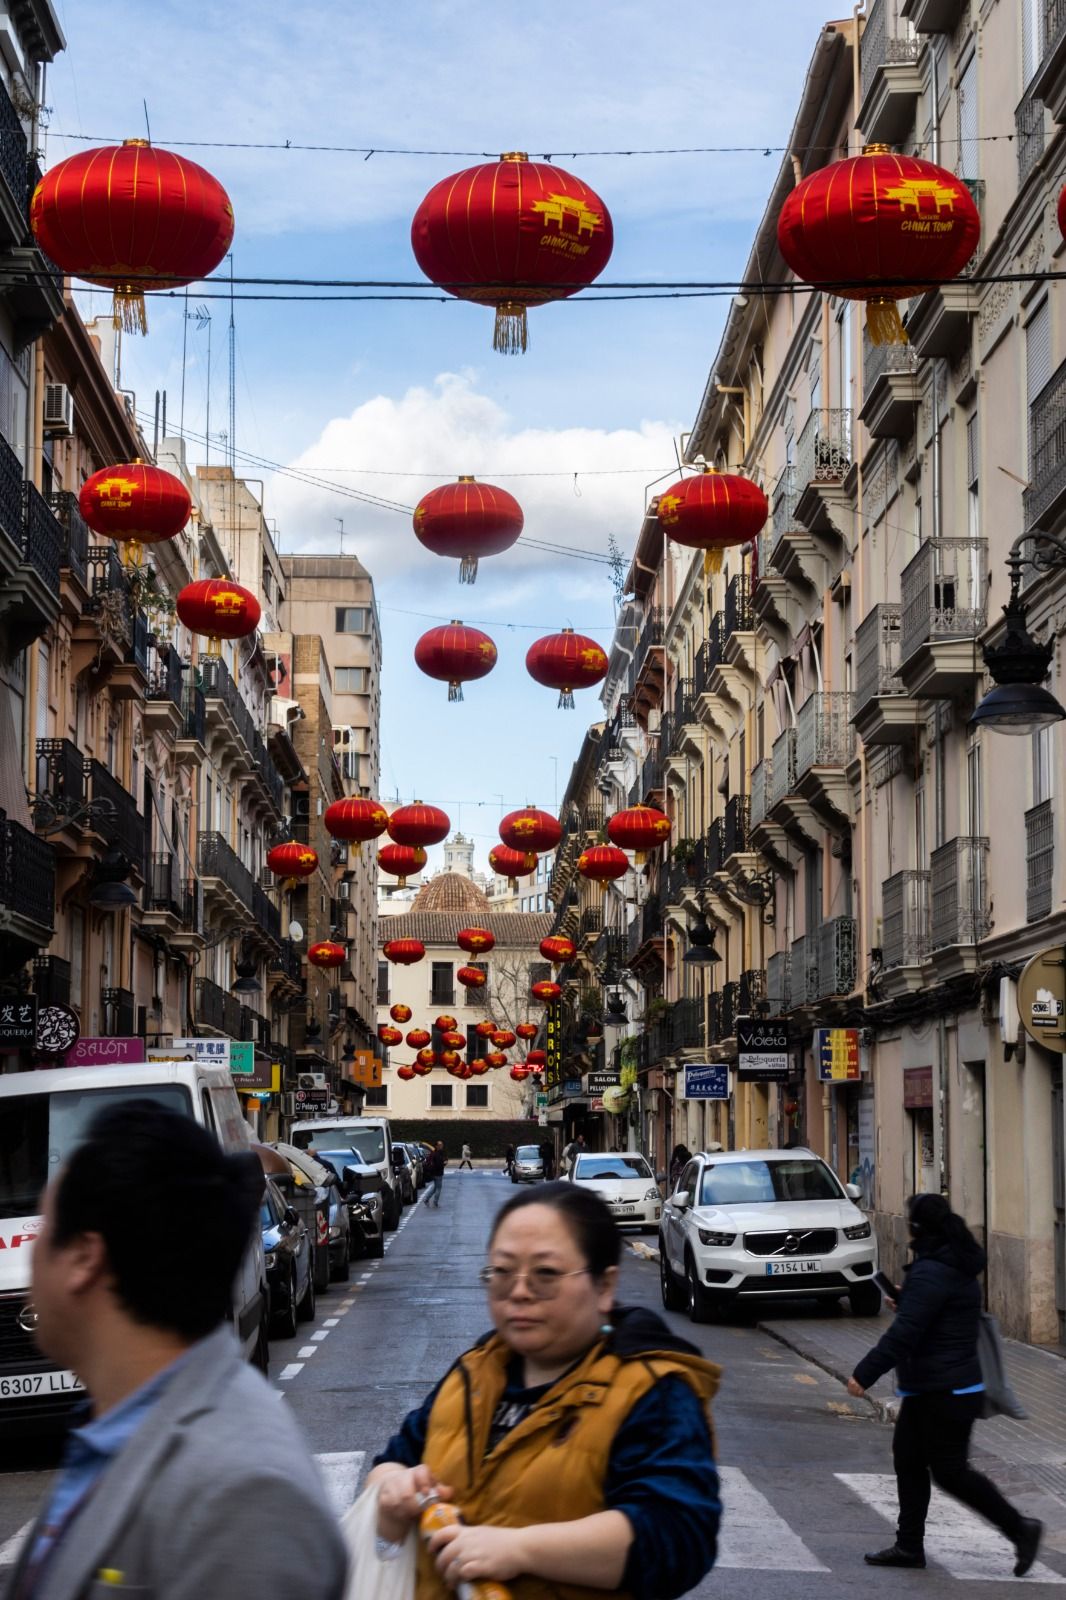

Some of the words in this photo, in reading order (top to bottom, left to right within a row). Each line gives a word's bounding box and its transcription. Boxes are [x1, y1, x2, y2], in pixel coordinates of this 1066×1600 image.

[901, 220, 931, 232] CHINA
[932, 220, 955, 232] TOWN
[540, 235, 569, 250] CHINA
[547, 1002, 556, 1084] IBROS
[740, 1033, 787, 1047] Violeta
[76, 1040, 128, 1058] SALÓN
[302, 1103, 319, 1112] Pelayo
[774, 1263, 798, 1274] 2154
[801, 1262, 820, 1272] LML
[1, 1376, 43, 1396] 6307
